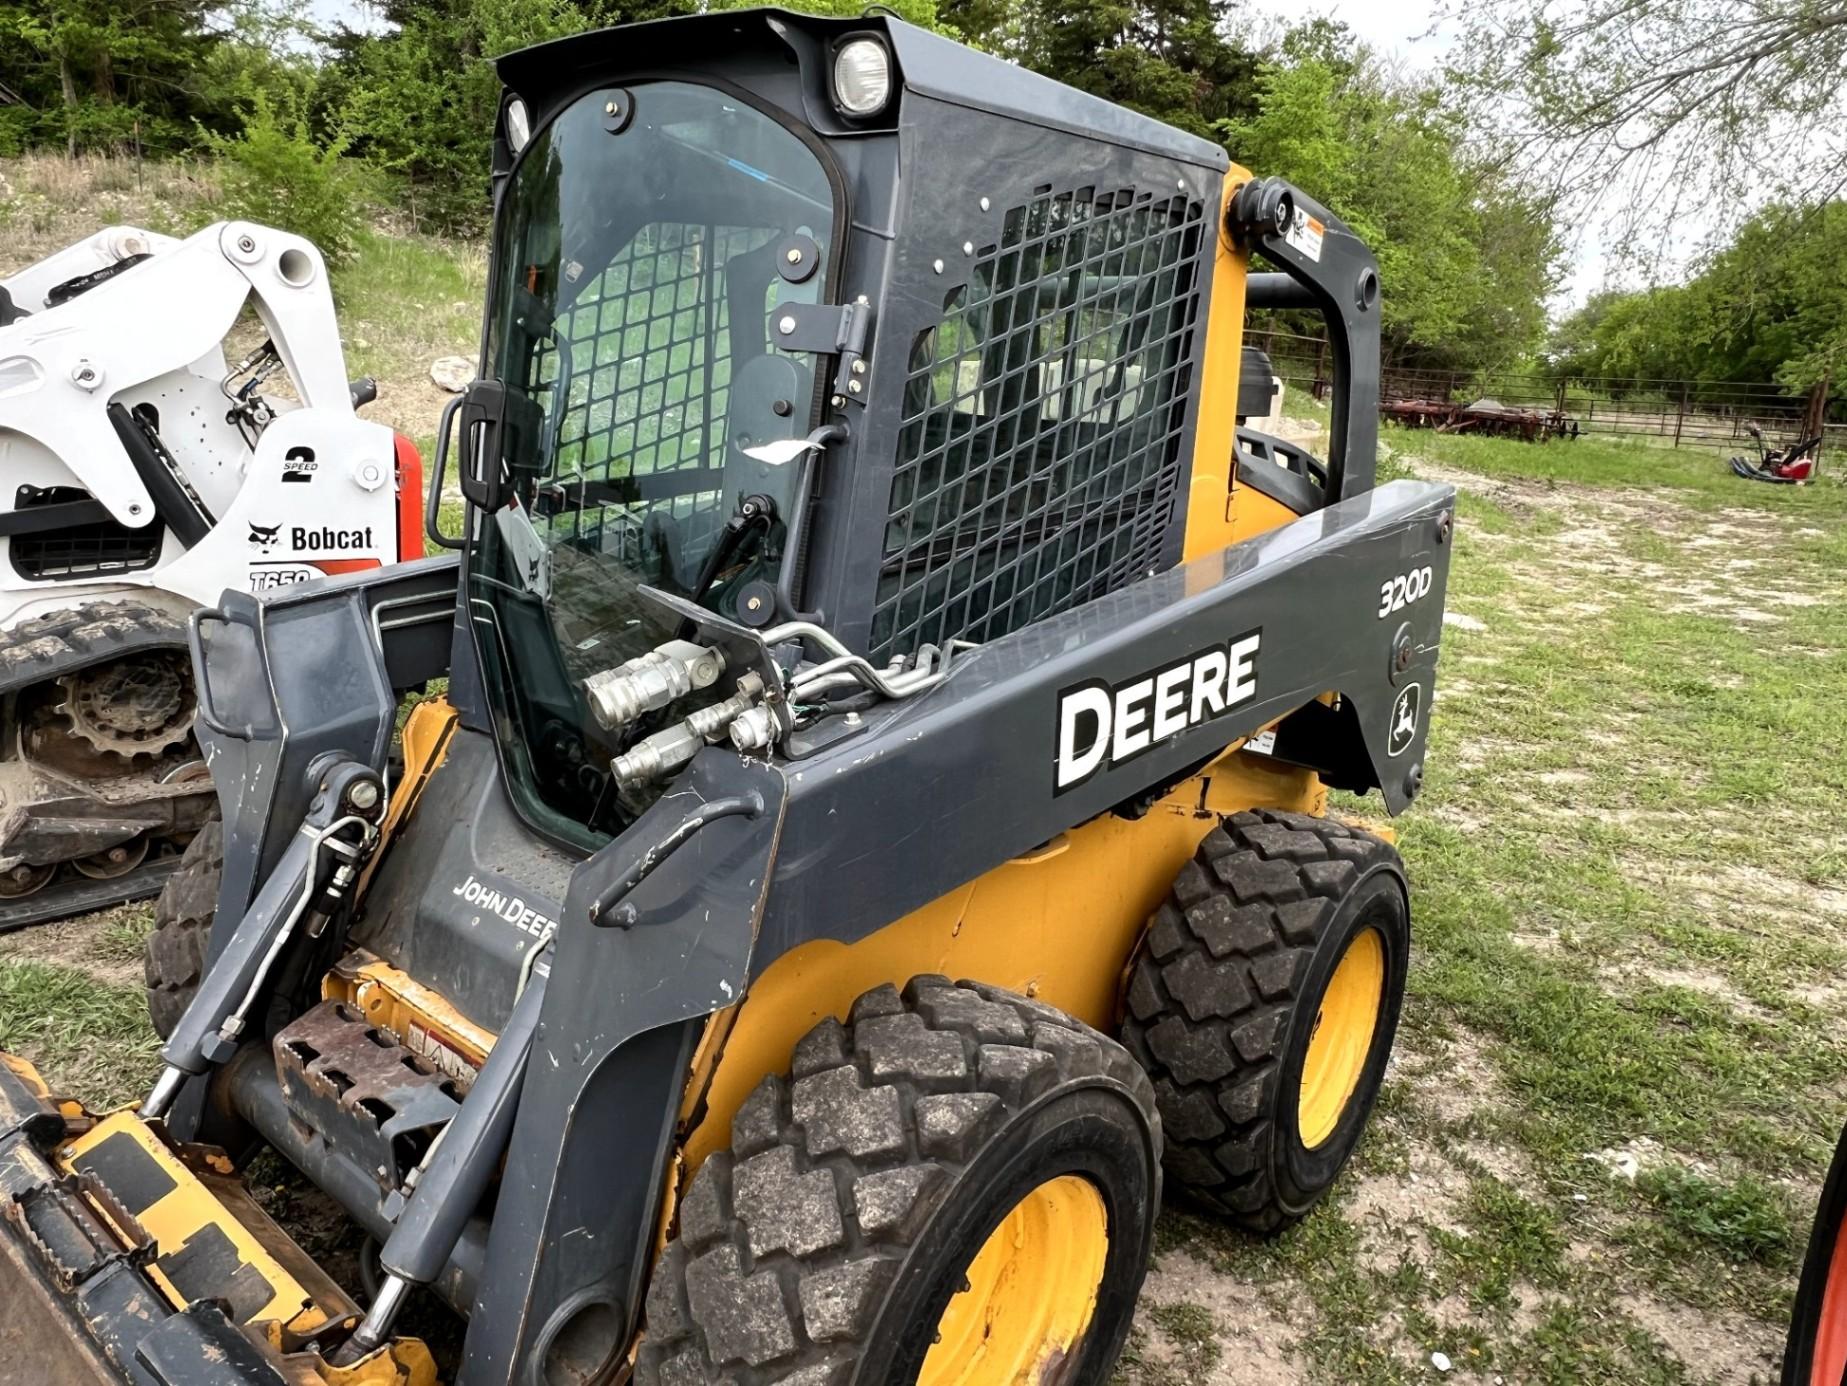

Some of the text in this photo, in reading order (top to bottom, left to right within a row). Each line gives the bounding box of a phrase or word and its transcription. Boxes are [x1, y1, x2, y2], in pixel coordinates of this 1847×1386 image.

[281, 446, 315, 483] 2
[283, 462, 319, 471] SPEED
[292, 527, 372, 551] Bobcat
[1378, 566, 1433, 619] 320D
[1057, 633, 1260, 788] DEERE
[453, 875, 508, 915] JOHN
